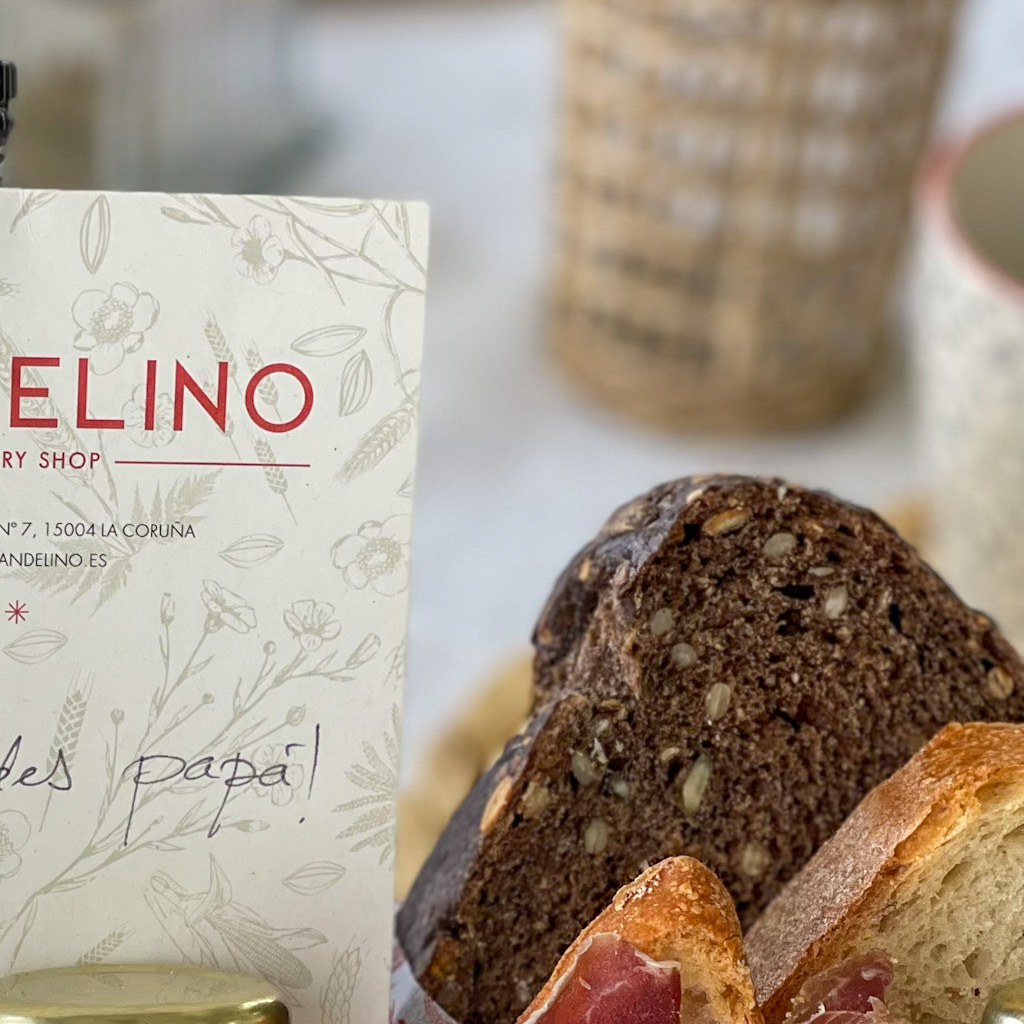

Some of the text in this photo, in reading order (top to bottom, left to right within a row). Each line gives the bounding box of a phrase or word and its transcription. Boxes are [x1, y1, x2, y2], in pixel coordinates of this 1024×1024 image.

[39, 451, 101, 469] SHOP
[45, 522, 96, 538] 15004
[101, 523, 118, 538] LA
[122, 520, 196, 539] CORUÑA
[123, 723, 321, 846] papá!
